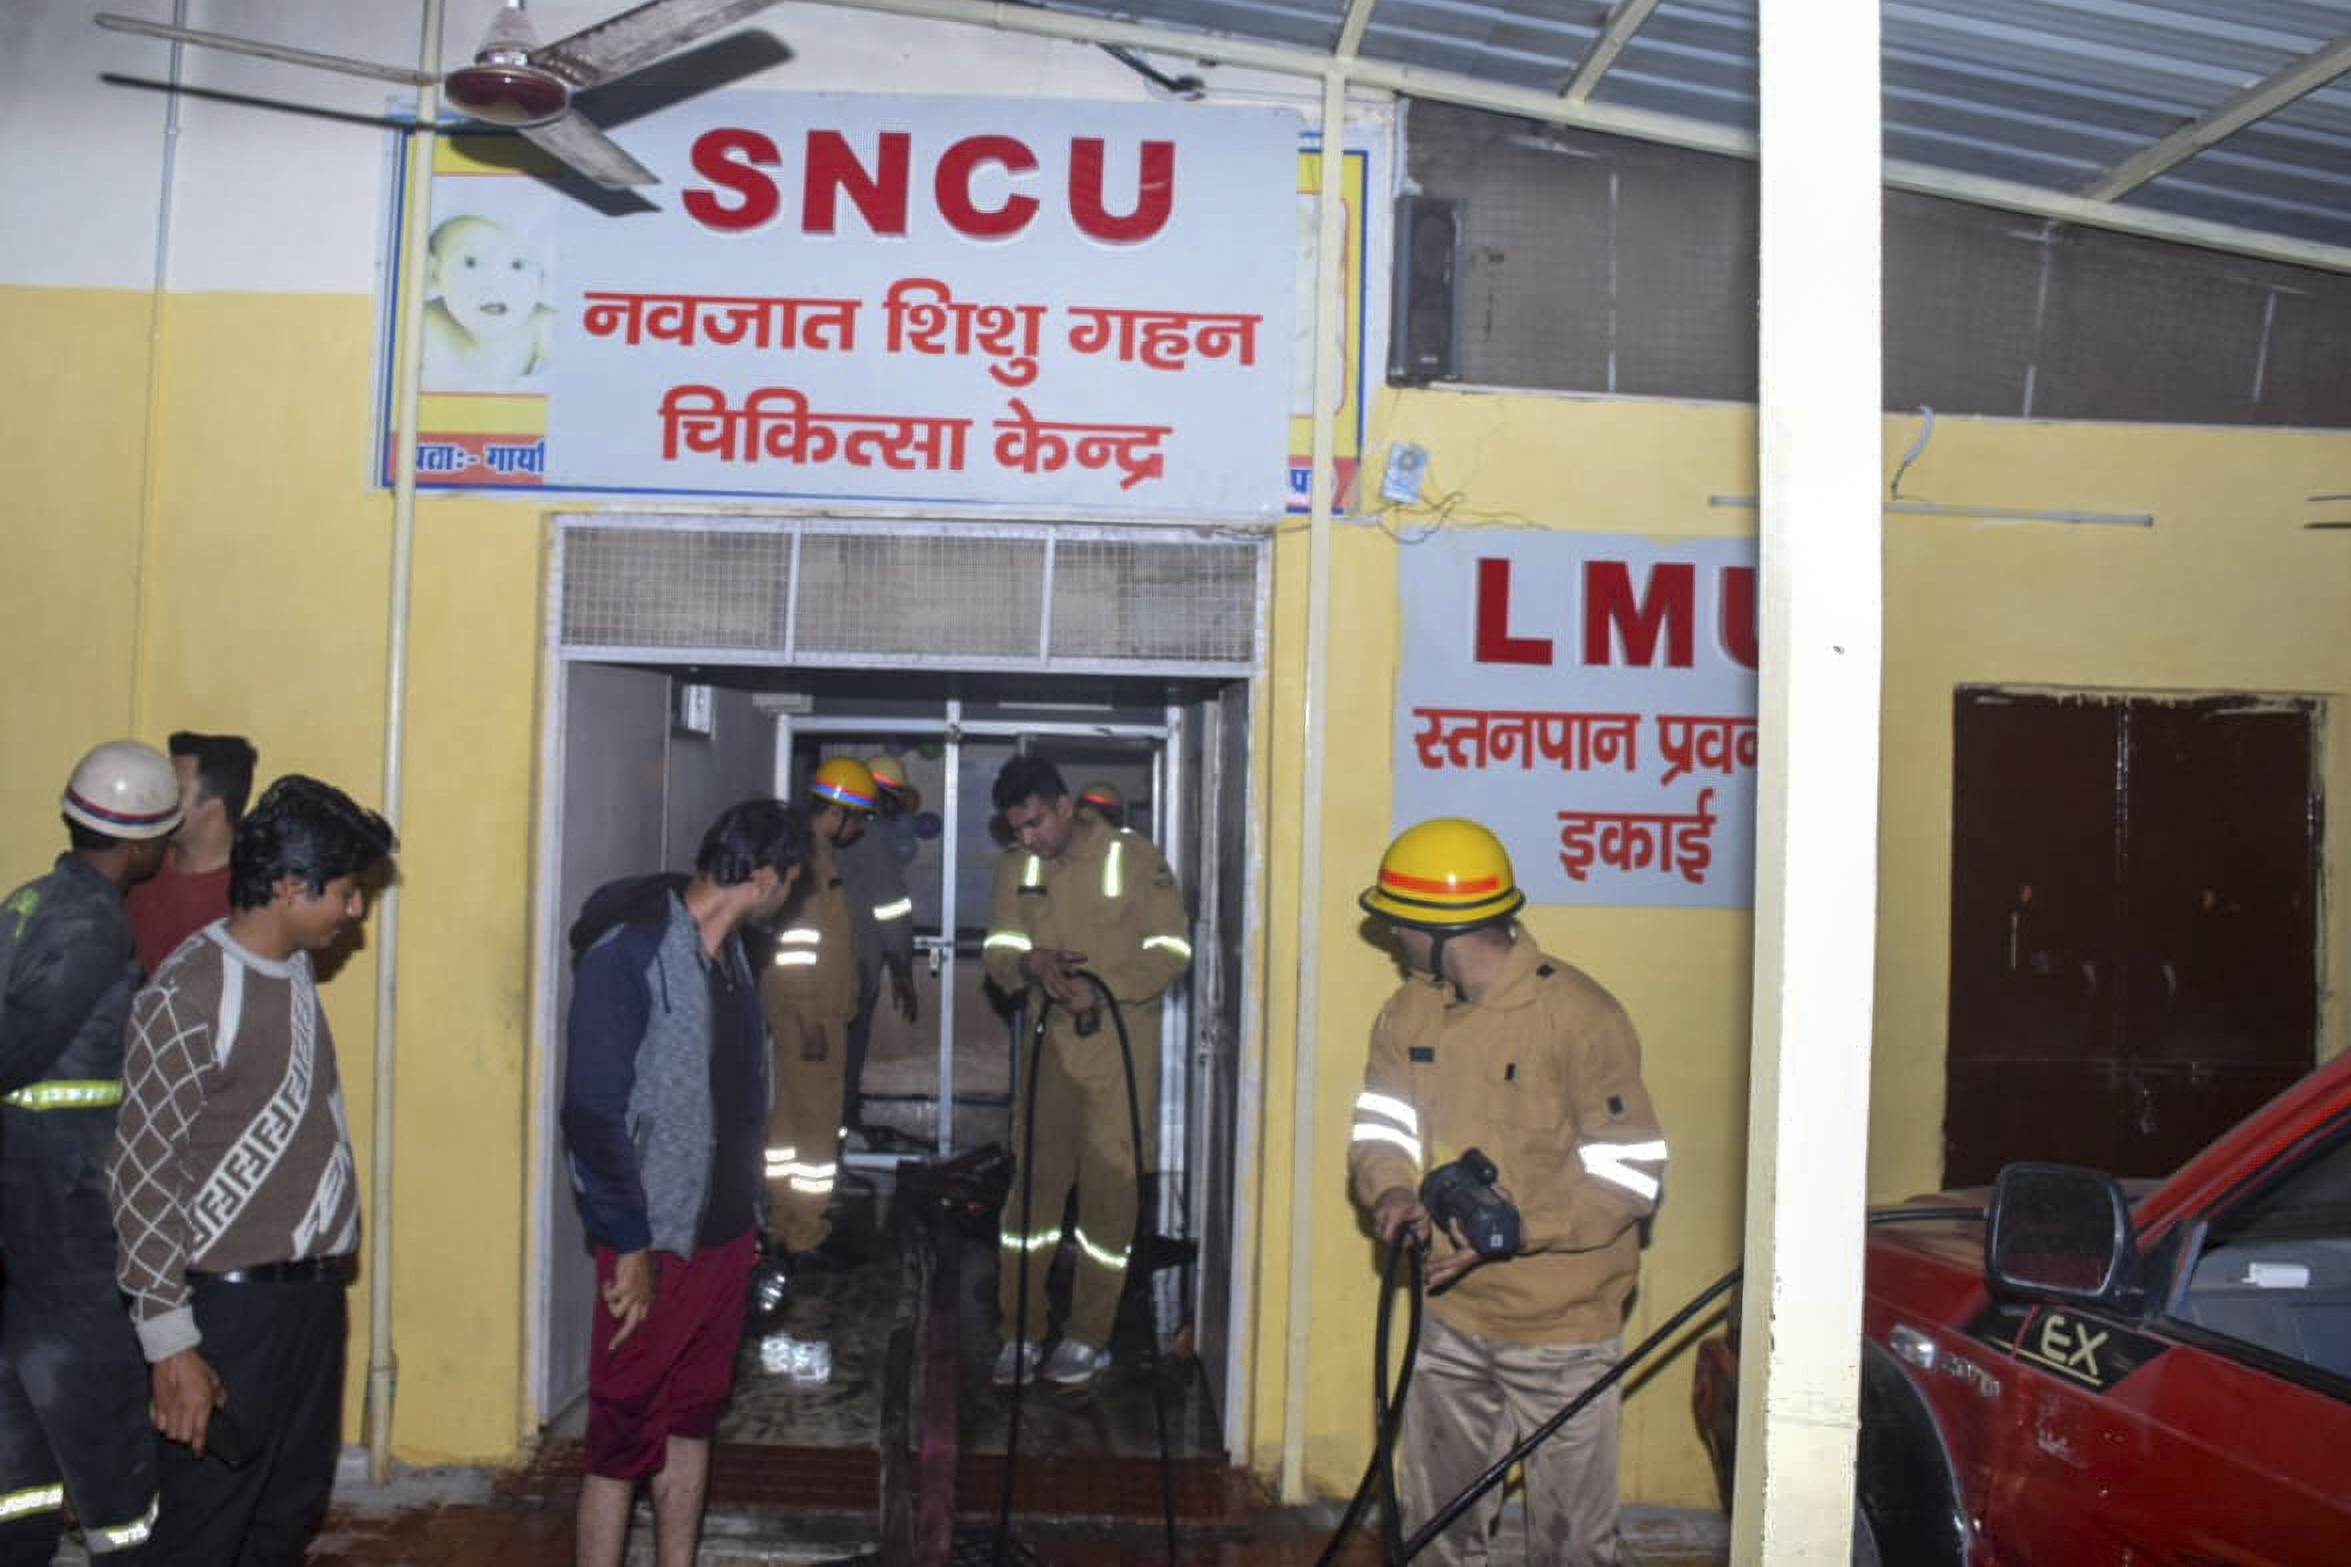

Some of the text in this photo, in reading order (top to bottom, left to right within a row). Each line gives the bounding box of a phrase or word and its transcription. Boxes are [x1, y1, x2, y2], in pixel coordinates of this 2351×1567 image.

[682, 129, 1175, 242] SNCU
[583, 277, 1265, 388] नवजात शिशु गहन
[658, 385, 1172, 490] चिकित्सा केन्द्र
[1414, 708, 1641, 772] स्तनपान
[1558, 788, 1717, 884] इकाई
[2040, 1314, 2108, 1377] EX
